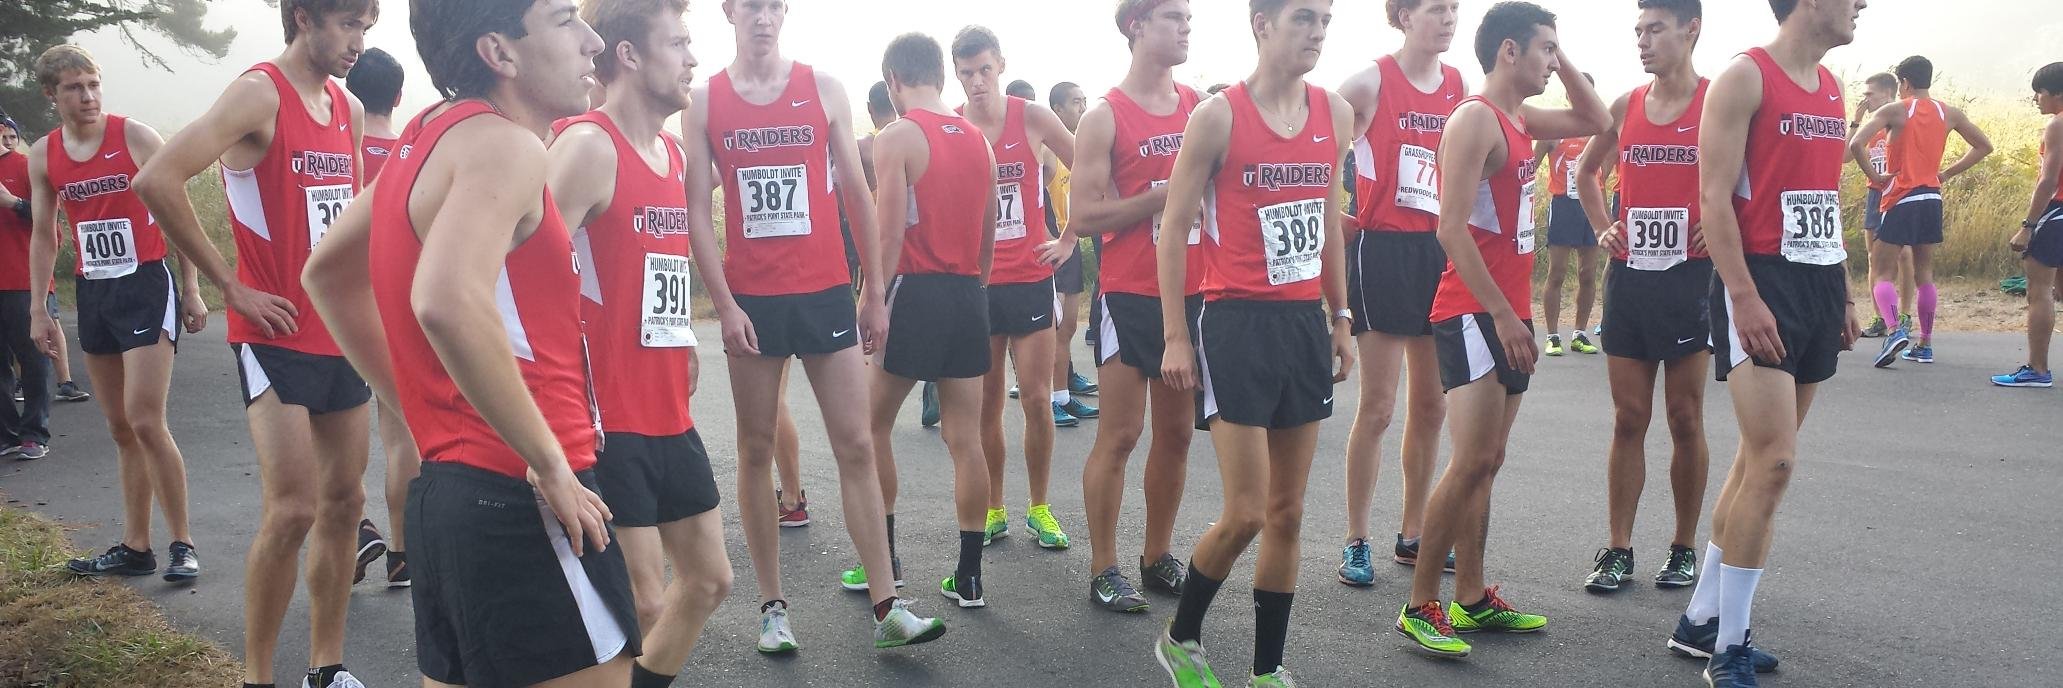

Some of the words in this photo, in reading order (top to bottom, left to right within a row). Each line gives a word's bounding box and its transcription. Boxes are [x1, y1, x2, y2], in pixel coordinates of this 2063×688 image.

[736, 126, 814, 152] RAIDERS
[1793, 114, 1846, 140] RAIDERS
[1630, 146, 1698, 166] RAIDERS
[66, 174, 129, 201] RAIDERS
[1258, 164, 1331, 190] RAIDERS
[748, 178, 798, 212] 387
[1272, 216, 1318, 256] 389
[1634, 220, 1678, 248] 390
[1793, 206, 1835, 239] 386
[86, 232, 126, 260] 400
[652, 273, 686, 316] 391
